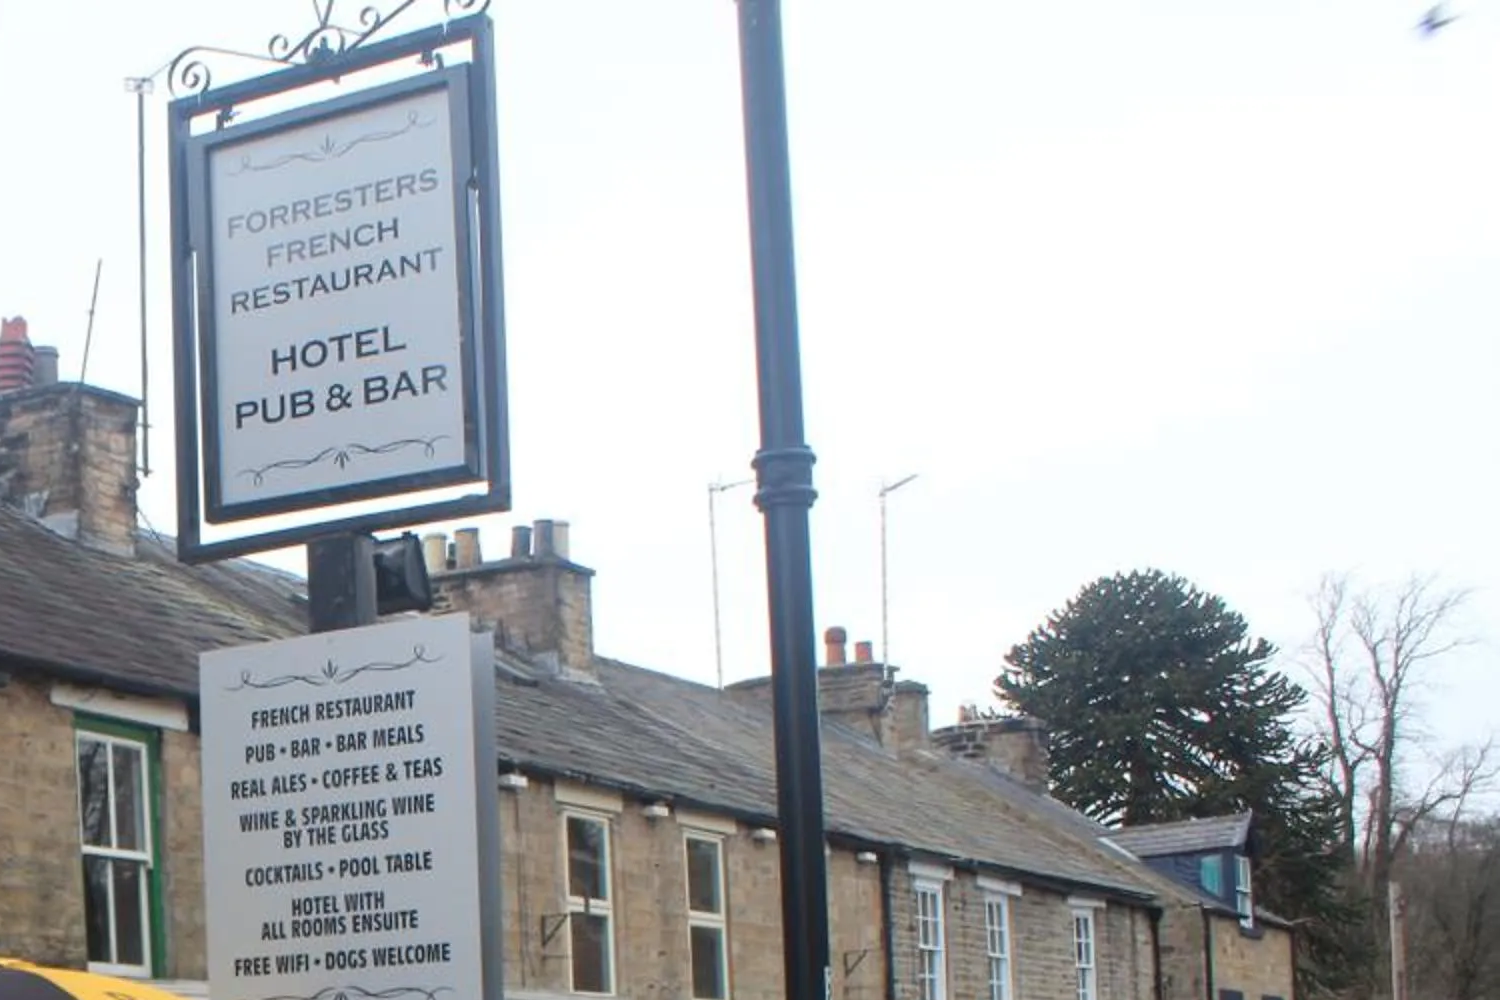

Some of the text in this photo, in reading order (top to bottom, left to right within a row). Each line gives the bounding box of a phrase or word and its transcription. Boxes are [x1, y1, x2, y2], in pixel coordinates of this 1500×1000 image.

[227, 169, 439, 238] FORRESTERS
[267, 217, 399, 268] FRENCH
[230, 248, 443, 314] RESTAURANT
[270, 325, 406, 375] HOTEL
[234, 365, 448, 430] PUB & BAR
[251, 690, 415, 729] FRENCH RESTAURANT
[245, 724, 424, 764] PUB BAR BAR MEALS
[231, 757, 443, 800] REAL ALES COFFEE & TEAS
[240, 794, 435, 832] WINE & SPARKLING WINE
[283, 820, 388, 848] BY THE GLASS
[245, 852, 432, 886] COCKTAILS POOL TABLE
[291, 891, 385, 916] HOTEL WITH
[261, 910, 418, 941] ALL ROOMS ENSUITE
[235, 943, 450, 976] FREE WIFI DOGS WELCOME
